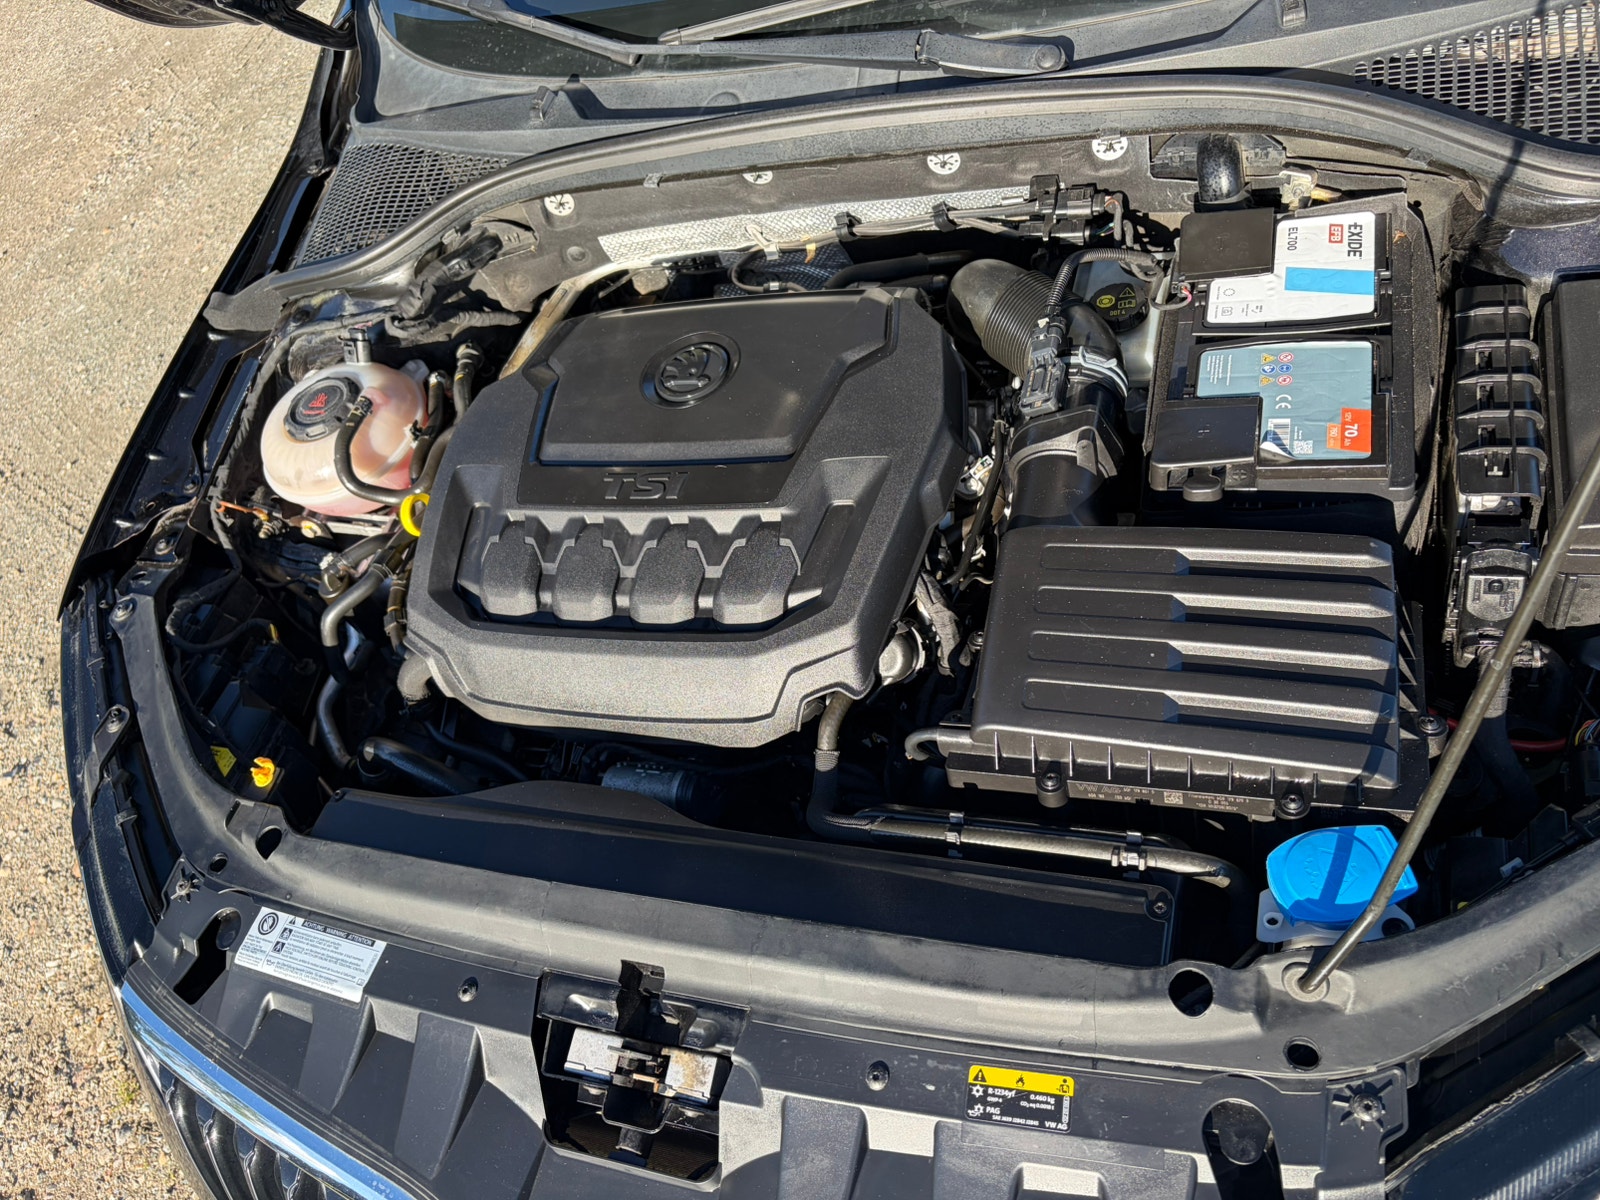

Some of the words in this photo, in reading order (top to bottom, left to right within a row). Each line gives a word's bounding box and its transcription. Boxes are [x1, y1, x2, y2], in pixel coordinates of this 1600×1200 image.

[1287, 226, 1298, 251] EL700
[1330, 225, 1342, 243] EFB
[1347, 222, 1363, 257] EXIDE
[1344, 423, 1359, 438] 70
[603, 472, 689, 500] TSI
[303, 920, 325, 932] ACHTUNG
[326, 925, 347, 939] WARNING
[348, 933, 373, 946] ATTENTION
[988, 1087, 1016, 1099] R-1234yf
[1047, 1096, 1056, 1104] kg
[986, 1106, 1000, 1114] PAG
[1057, 1122, 1068, 1130] AG
